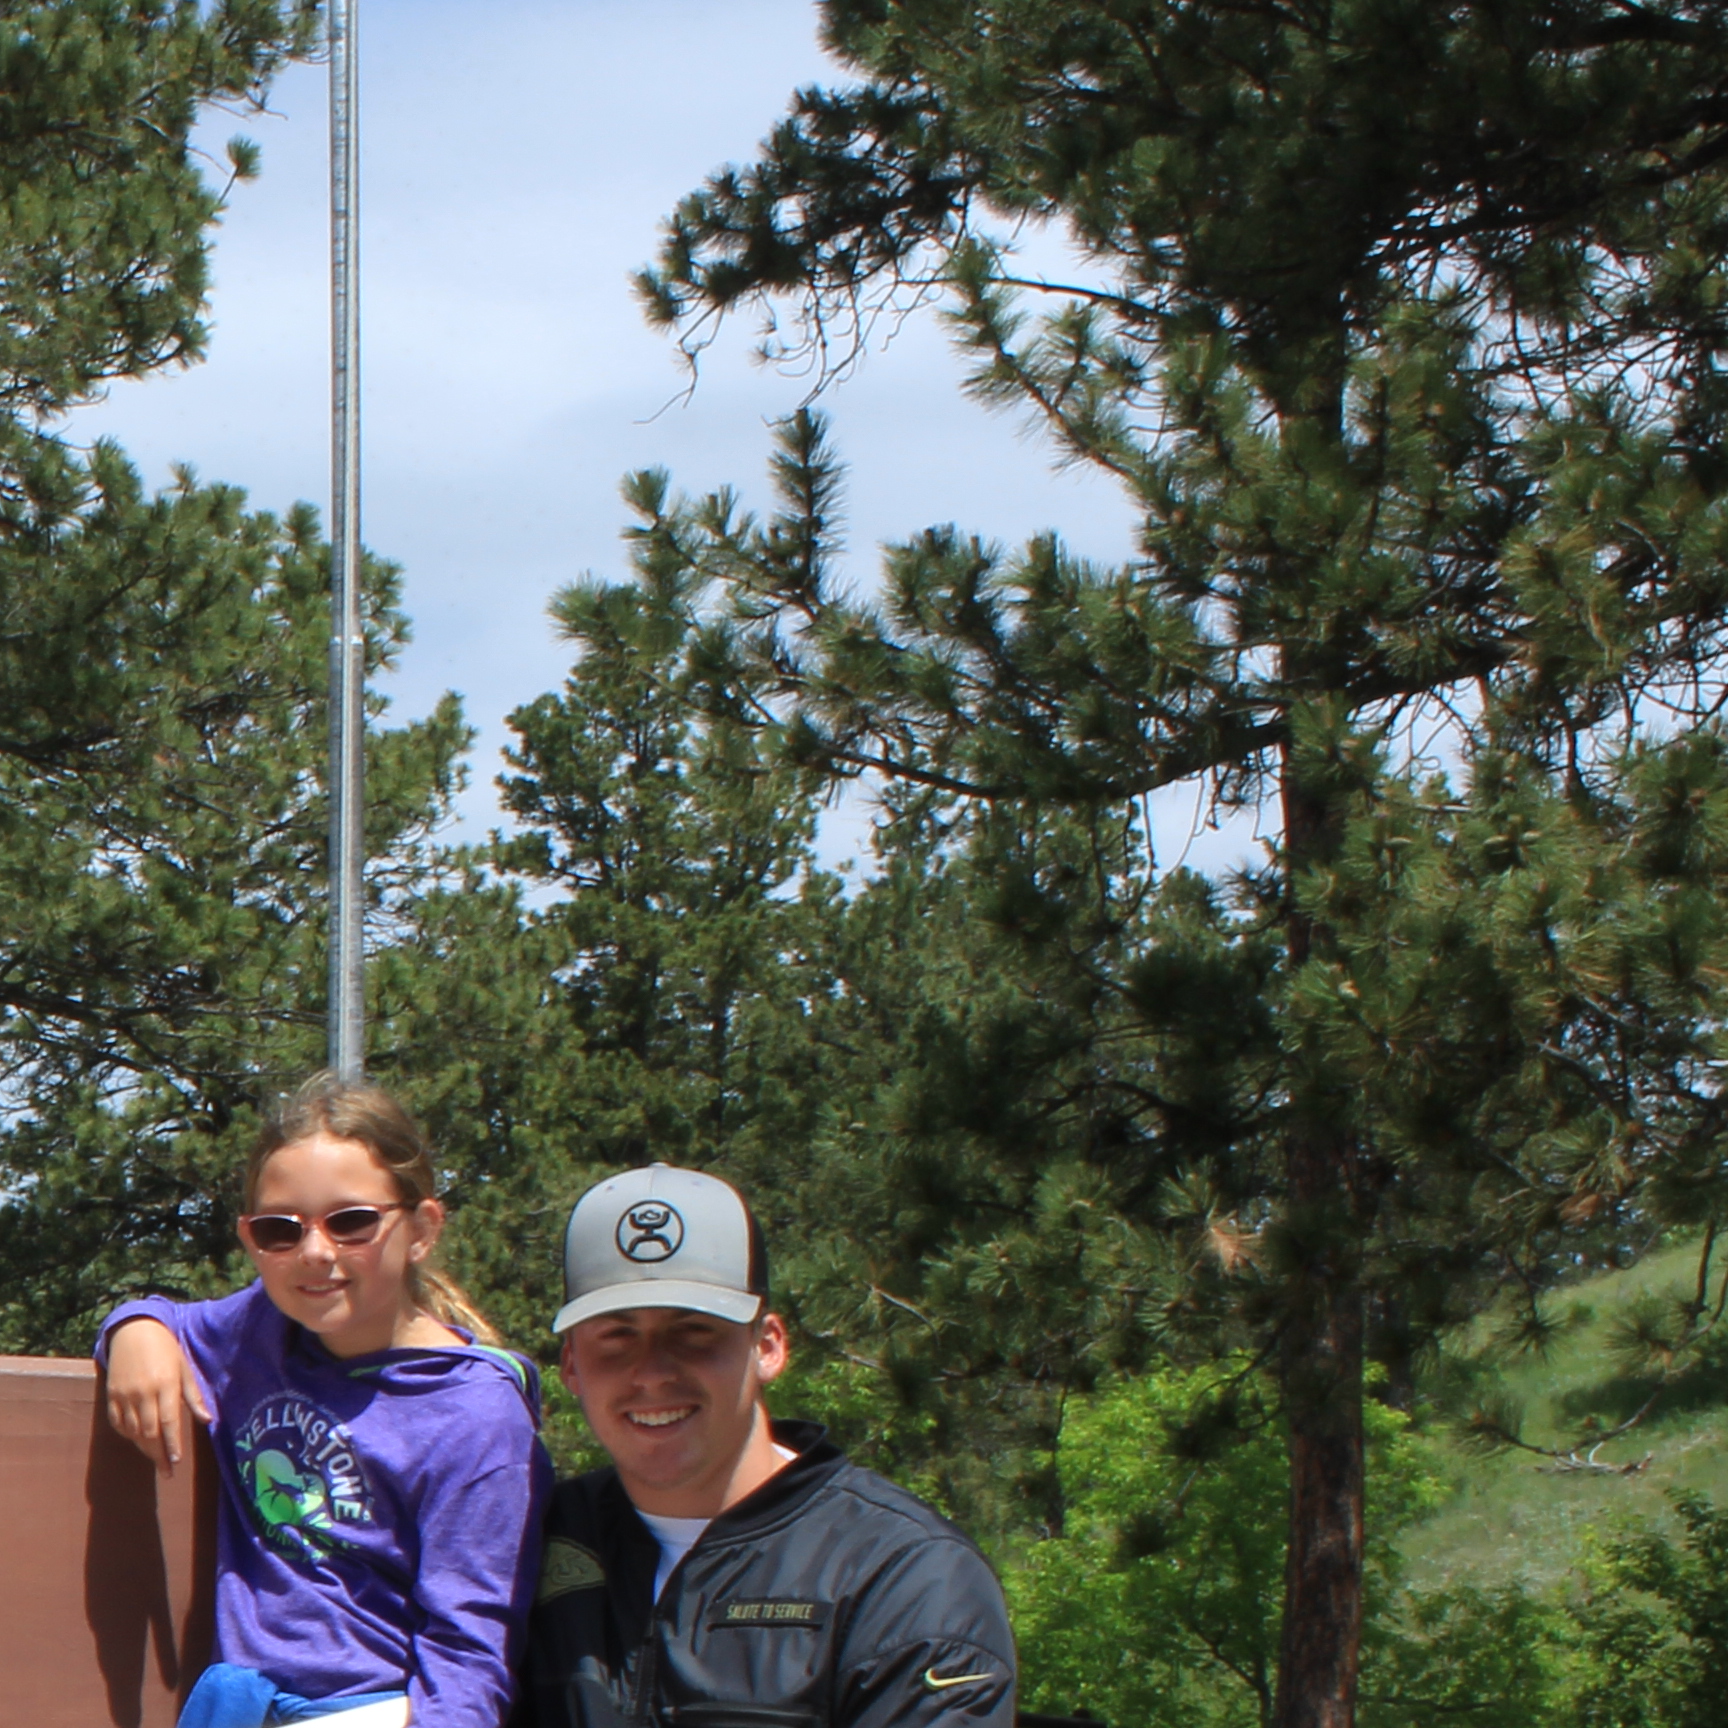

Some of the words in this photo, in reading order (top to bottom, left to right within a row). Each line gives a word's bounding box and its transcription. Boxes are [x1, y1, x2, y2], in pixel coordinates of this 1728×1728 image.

[727, 1603, 761, 1620] SALUTE
[762, 1602, 775, 1619] TO
[775, 1603, 814, 1619] SERVICE
